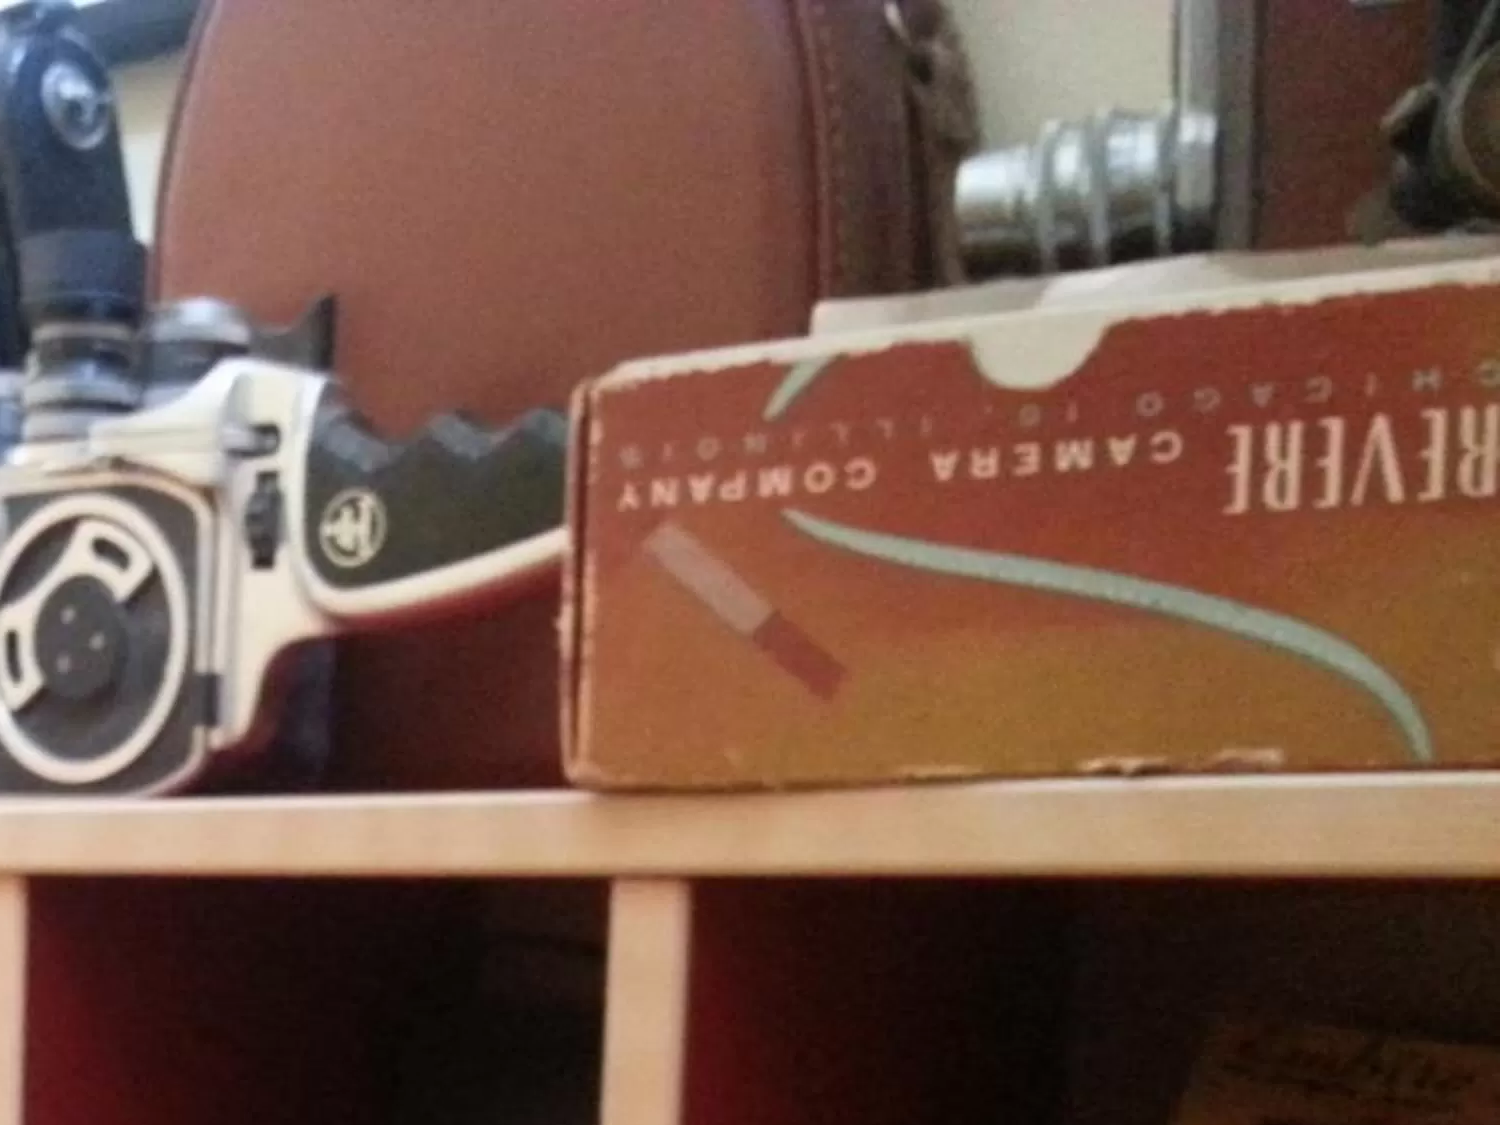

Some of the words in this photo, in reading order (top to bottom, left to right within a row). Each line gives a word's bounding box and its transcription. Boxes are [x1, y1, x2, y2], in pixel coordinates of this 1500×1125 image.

[1135, 360, 1500, 418] CHICAGO
[929, 431, 1184, 480] CAMERA
[1222, 403, 1500, 515] REVERE
[617, 457, 876, 512] COMPANY
